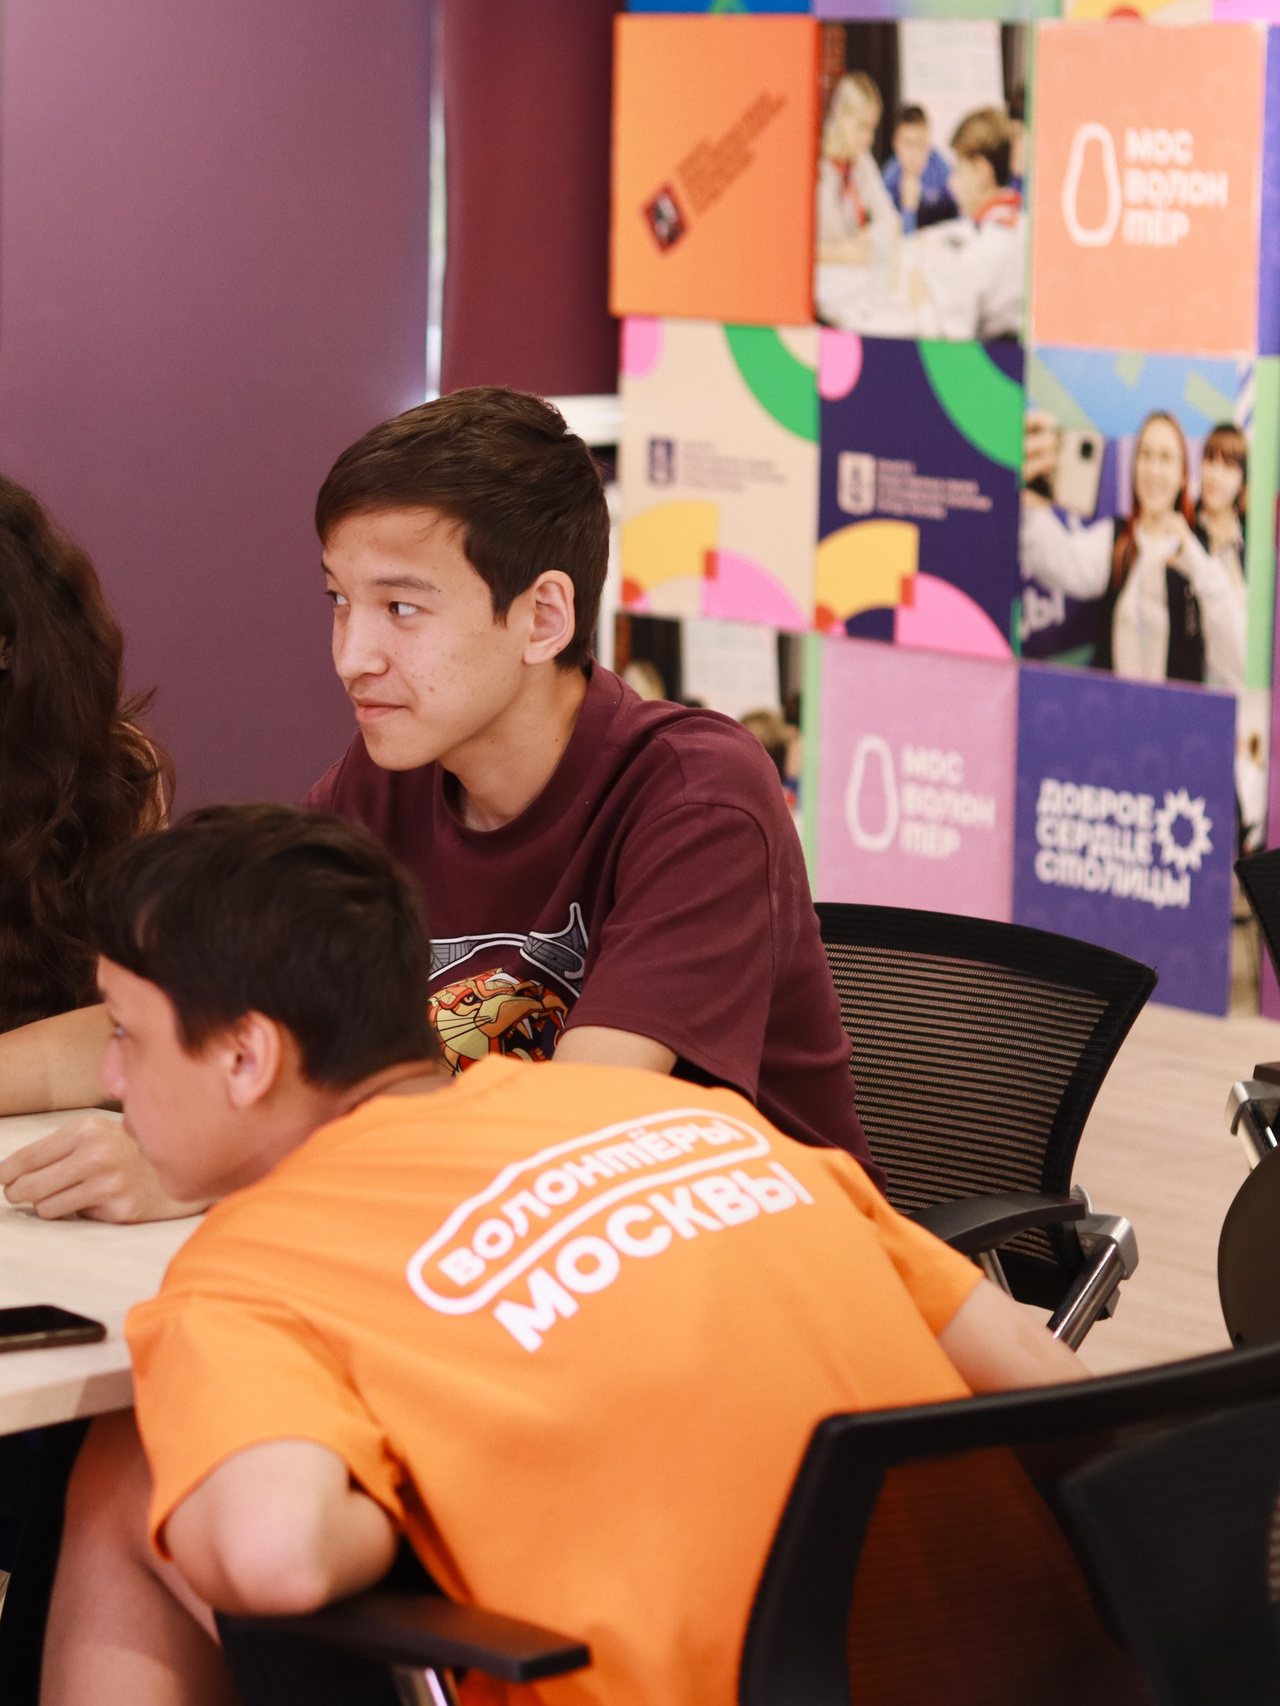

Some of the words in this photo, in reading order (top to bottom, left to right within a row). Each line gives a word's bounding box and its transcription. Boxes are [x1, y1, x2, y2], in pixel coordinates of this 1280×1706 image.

[1124, 127, 1195, 165] МОС
[1124, 167, 1229, 209] ВОЛОН
[902, 746, 965, 784] МОС
[902, 783, 996, 829] ВОЛОН
[1036, 778, 1155, 829] ДОБРОЕ
[1035, 815, 1154, 866] СЕРДЦЕ
[1034, 850, 1191, 909] СТОЛИЦЫ
[437, 1119, 745, 1286] ВОЛОНТЁРЫ
[493, 1161, 816, 1353] МОСКВЫ
